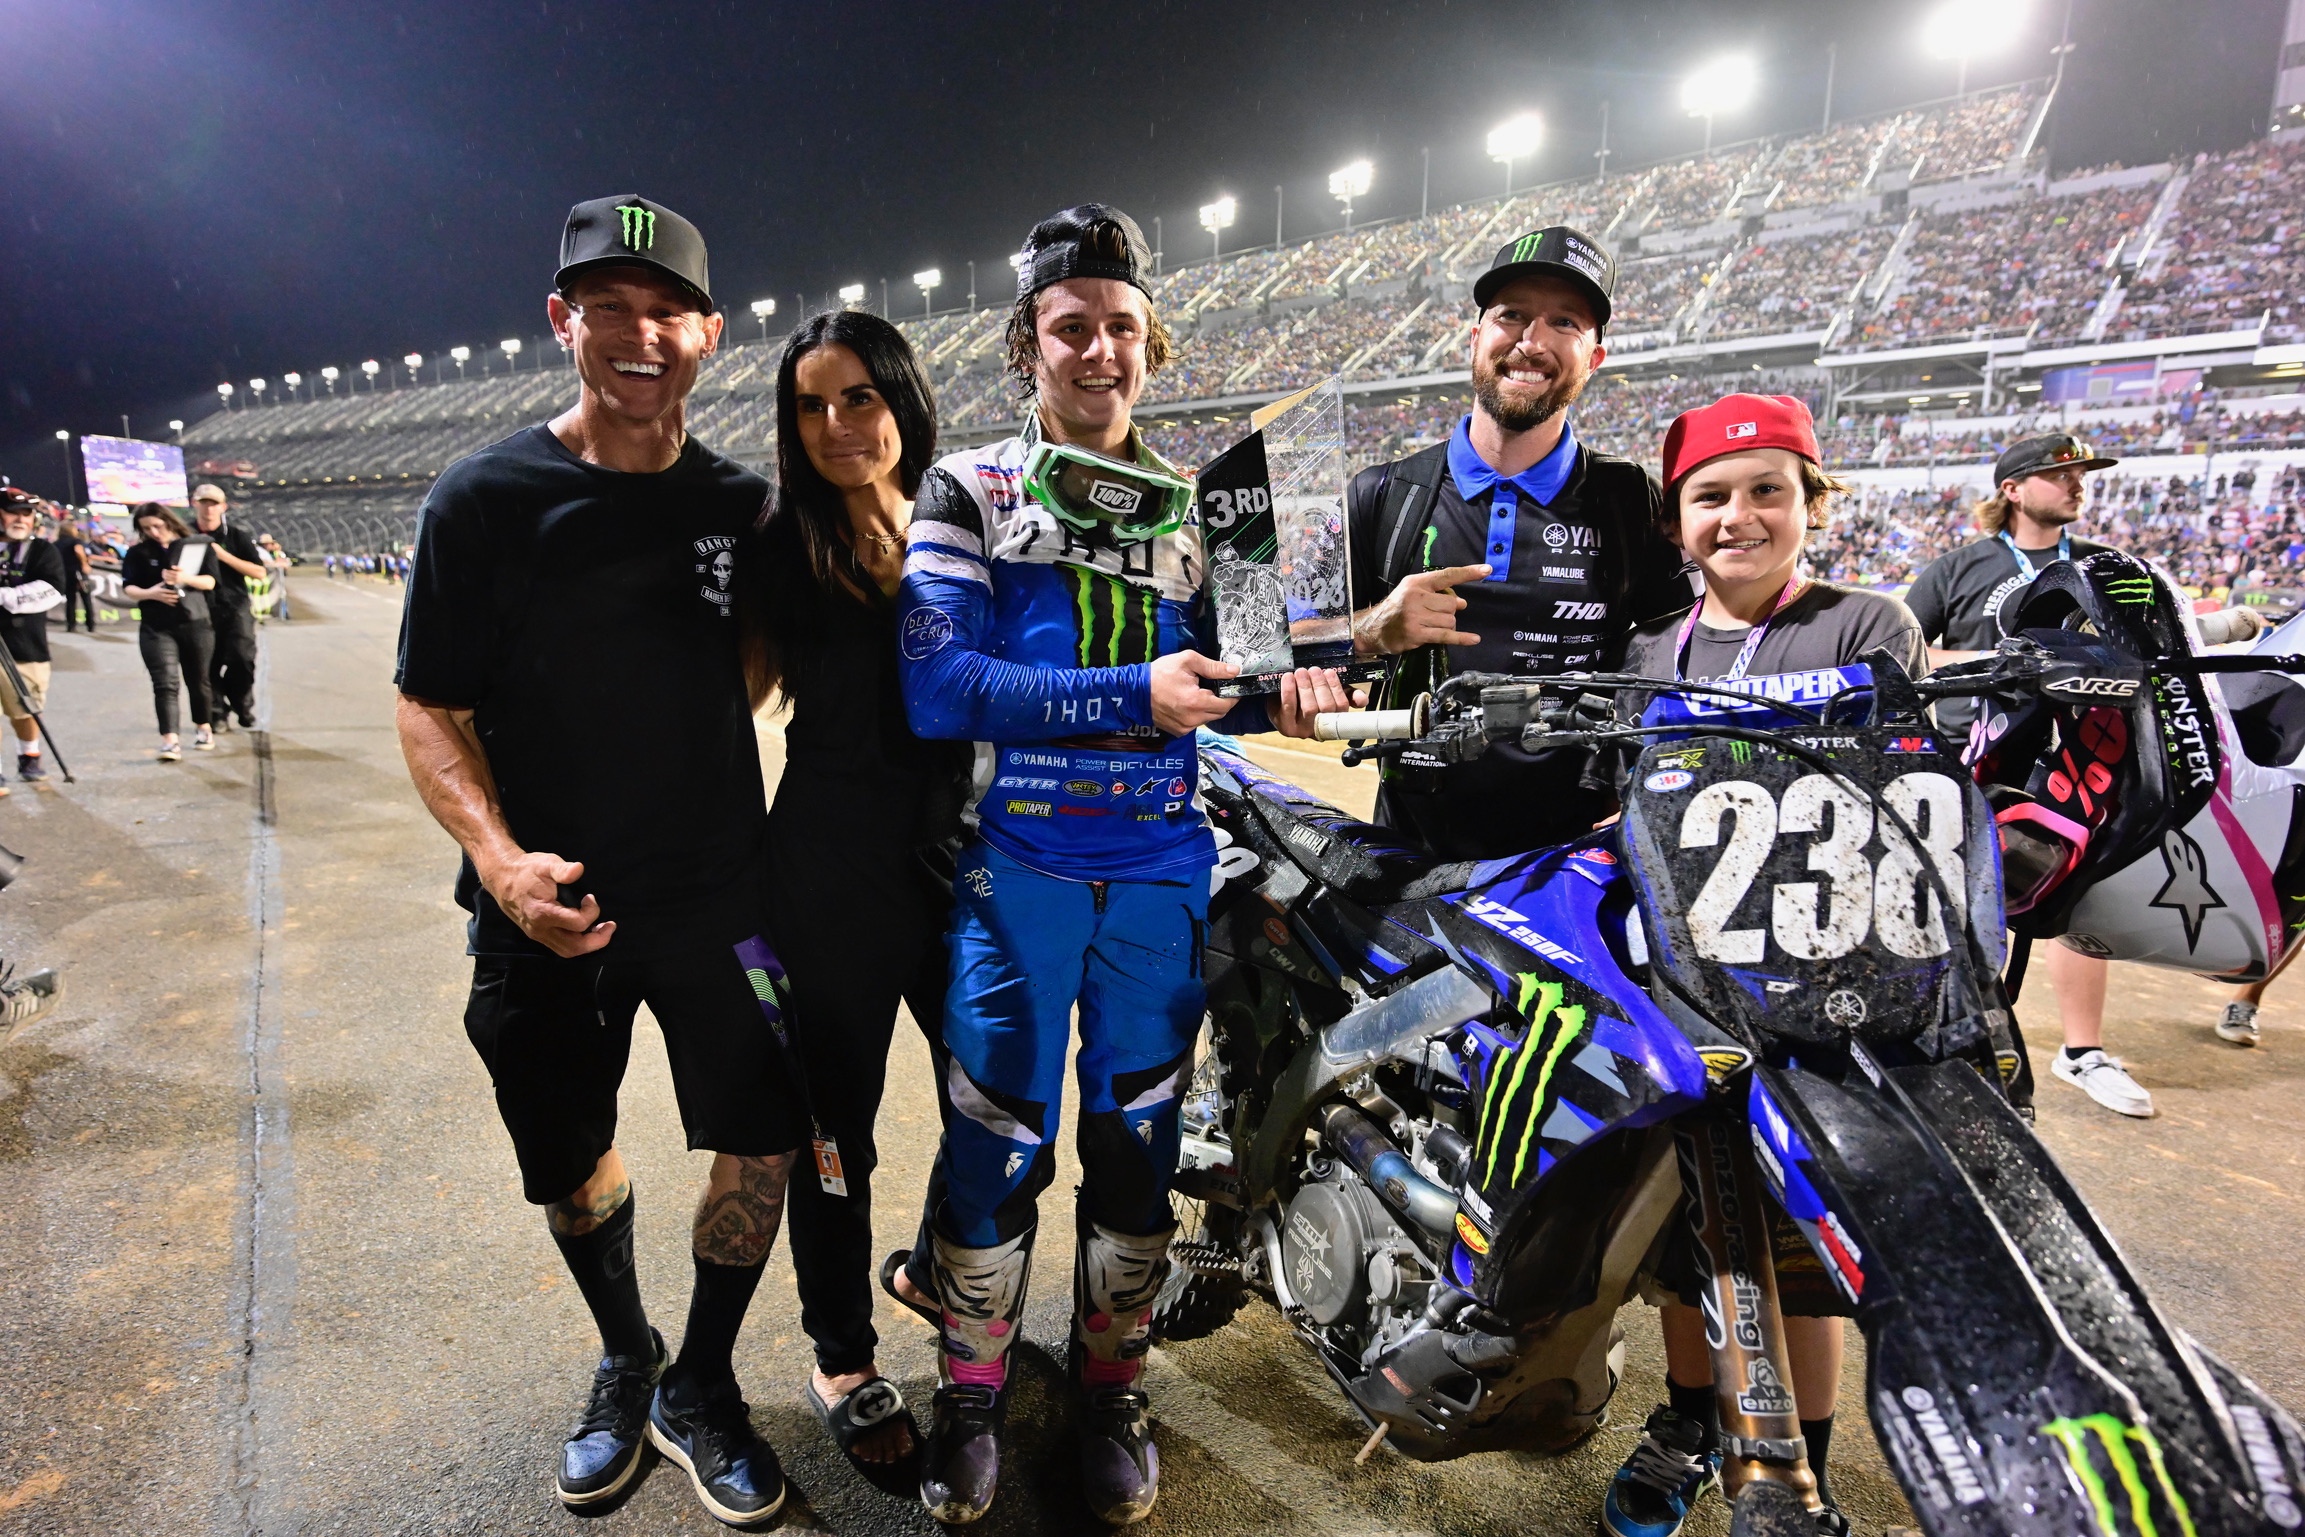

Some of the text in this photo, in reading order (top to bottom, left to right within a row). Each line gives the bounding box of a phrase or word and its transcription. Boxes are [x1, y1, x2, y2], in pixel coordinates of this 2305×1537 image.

[1567, 250, 1602, 281] YAMALUBE
[1577, 242, 1608, 272] YAMAHA
[1096, 486, 1136, 509] 100%
[1204, 487, 1270, 529] 3RD
[1542, 566, 1585, 579] YAMALUBE
[1982, 573, 2029, 617] PRESTIGE
[1524, 632, 1558, 643] YAMAHA
[1512, 651, 1555, 659] REKLUSE
[2151, 676, 2181, 769] ENERGY
[2160, 673, 2215, 788] ONSTER
[1758, 735, 1861, 754] MNSTER
[1023, 753, 1068, 768] YAMAHA
[1075, 758, 1107, 766] POWER
[997, 776, 1060, 790] GYTR
[1008, 801, 1052, 816] PROTAPER
[1288, 824, 1330, 857] YAMAHA
[1679, 772, 1967, 964] 238
[1453, 894, 1584, 964] YZ 250F
[1288, 1227, 1333, 1280] REKLUSE
[1742, 1397, 1793, 1411] enzo
